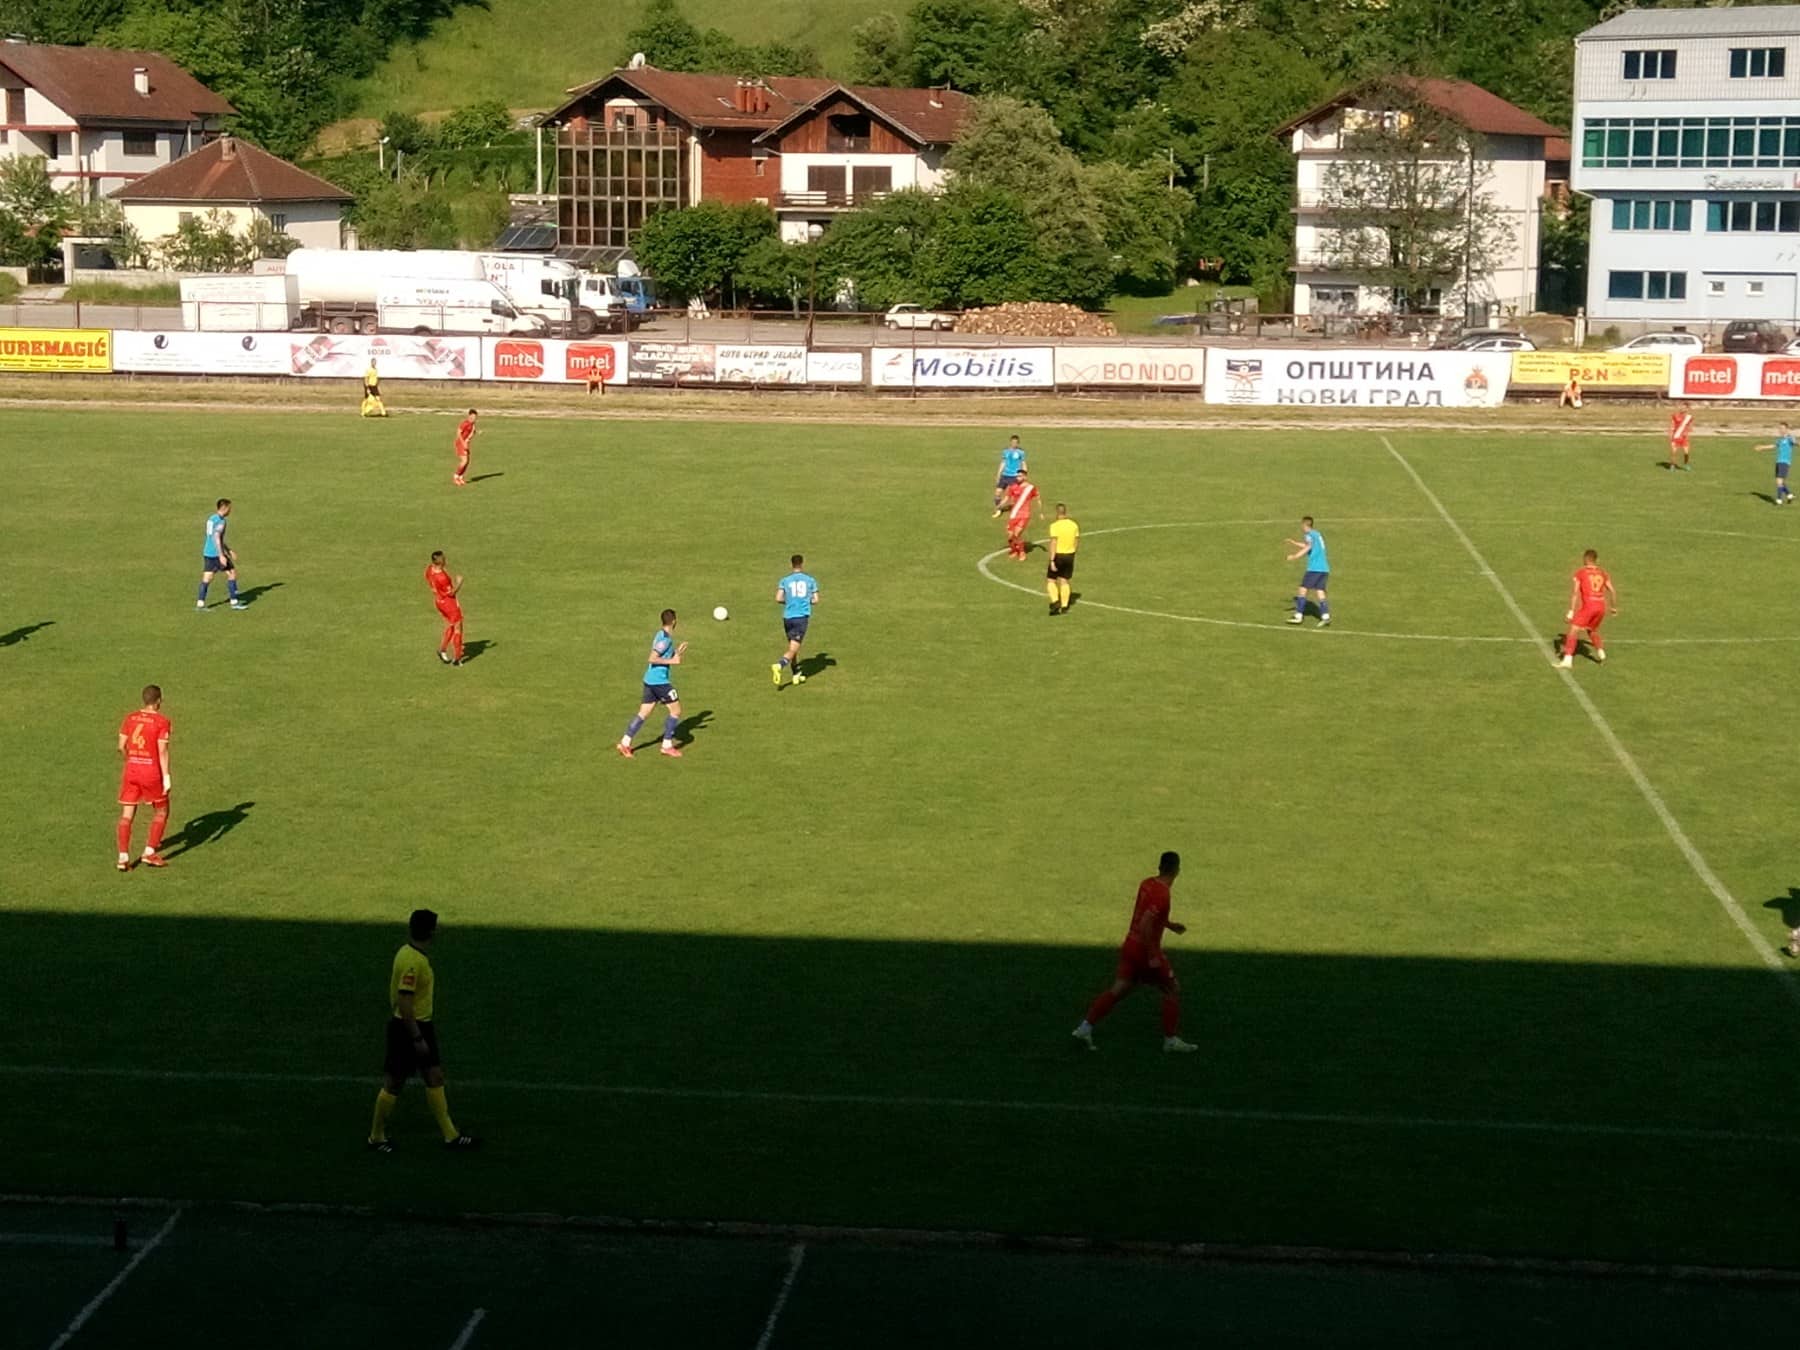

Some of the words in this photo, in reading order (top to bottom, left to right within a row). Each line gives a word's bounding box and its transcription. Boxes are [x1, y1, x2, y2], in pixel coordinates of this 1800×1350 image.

[914, 358, 1034, 377] Mobilis
[1286, 360, 1435, 381] ОПШТИНА
[1689, 366, 1732, 385] m:tel
[1277, 388, 1358, 405] НОВИ
[788, 580, 808, 598] 19
